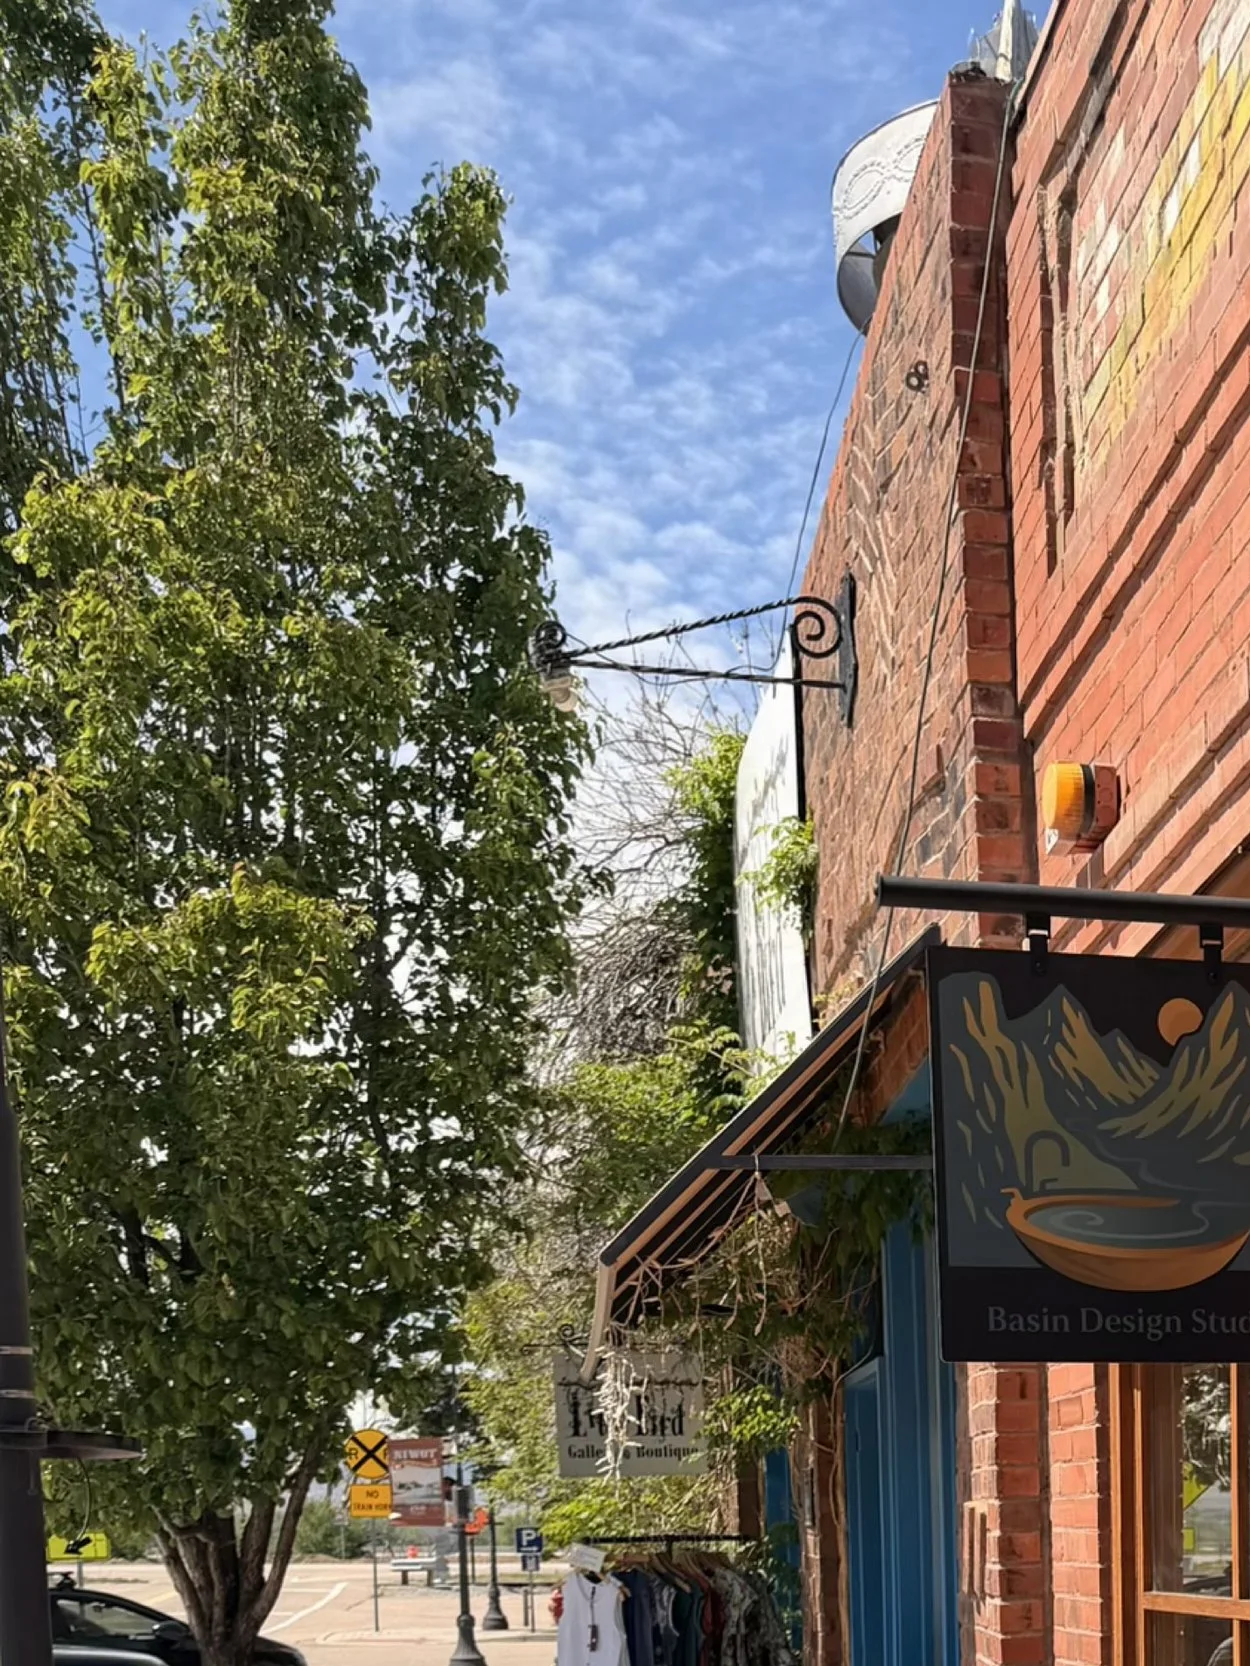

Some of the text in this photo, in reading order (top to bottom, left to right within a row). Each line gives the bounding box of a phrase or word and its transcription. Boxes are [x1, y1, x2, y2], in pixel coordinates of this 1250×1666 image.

[986, 1305, 1070, 1333] Basin
[1080, 1306, 1182, 1341] Design
[636, 1444, 699, 1463] Boutique
[521, 1530, 537, 1546] P
